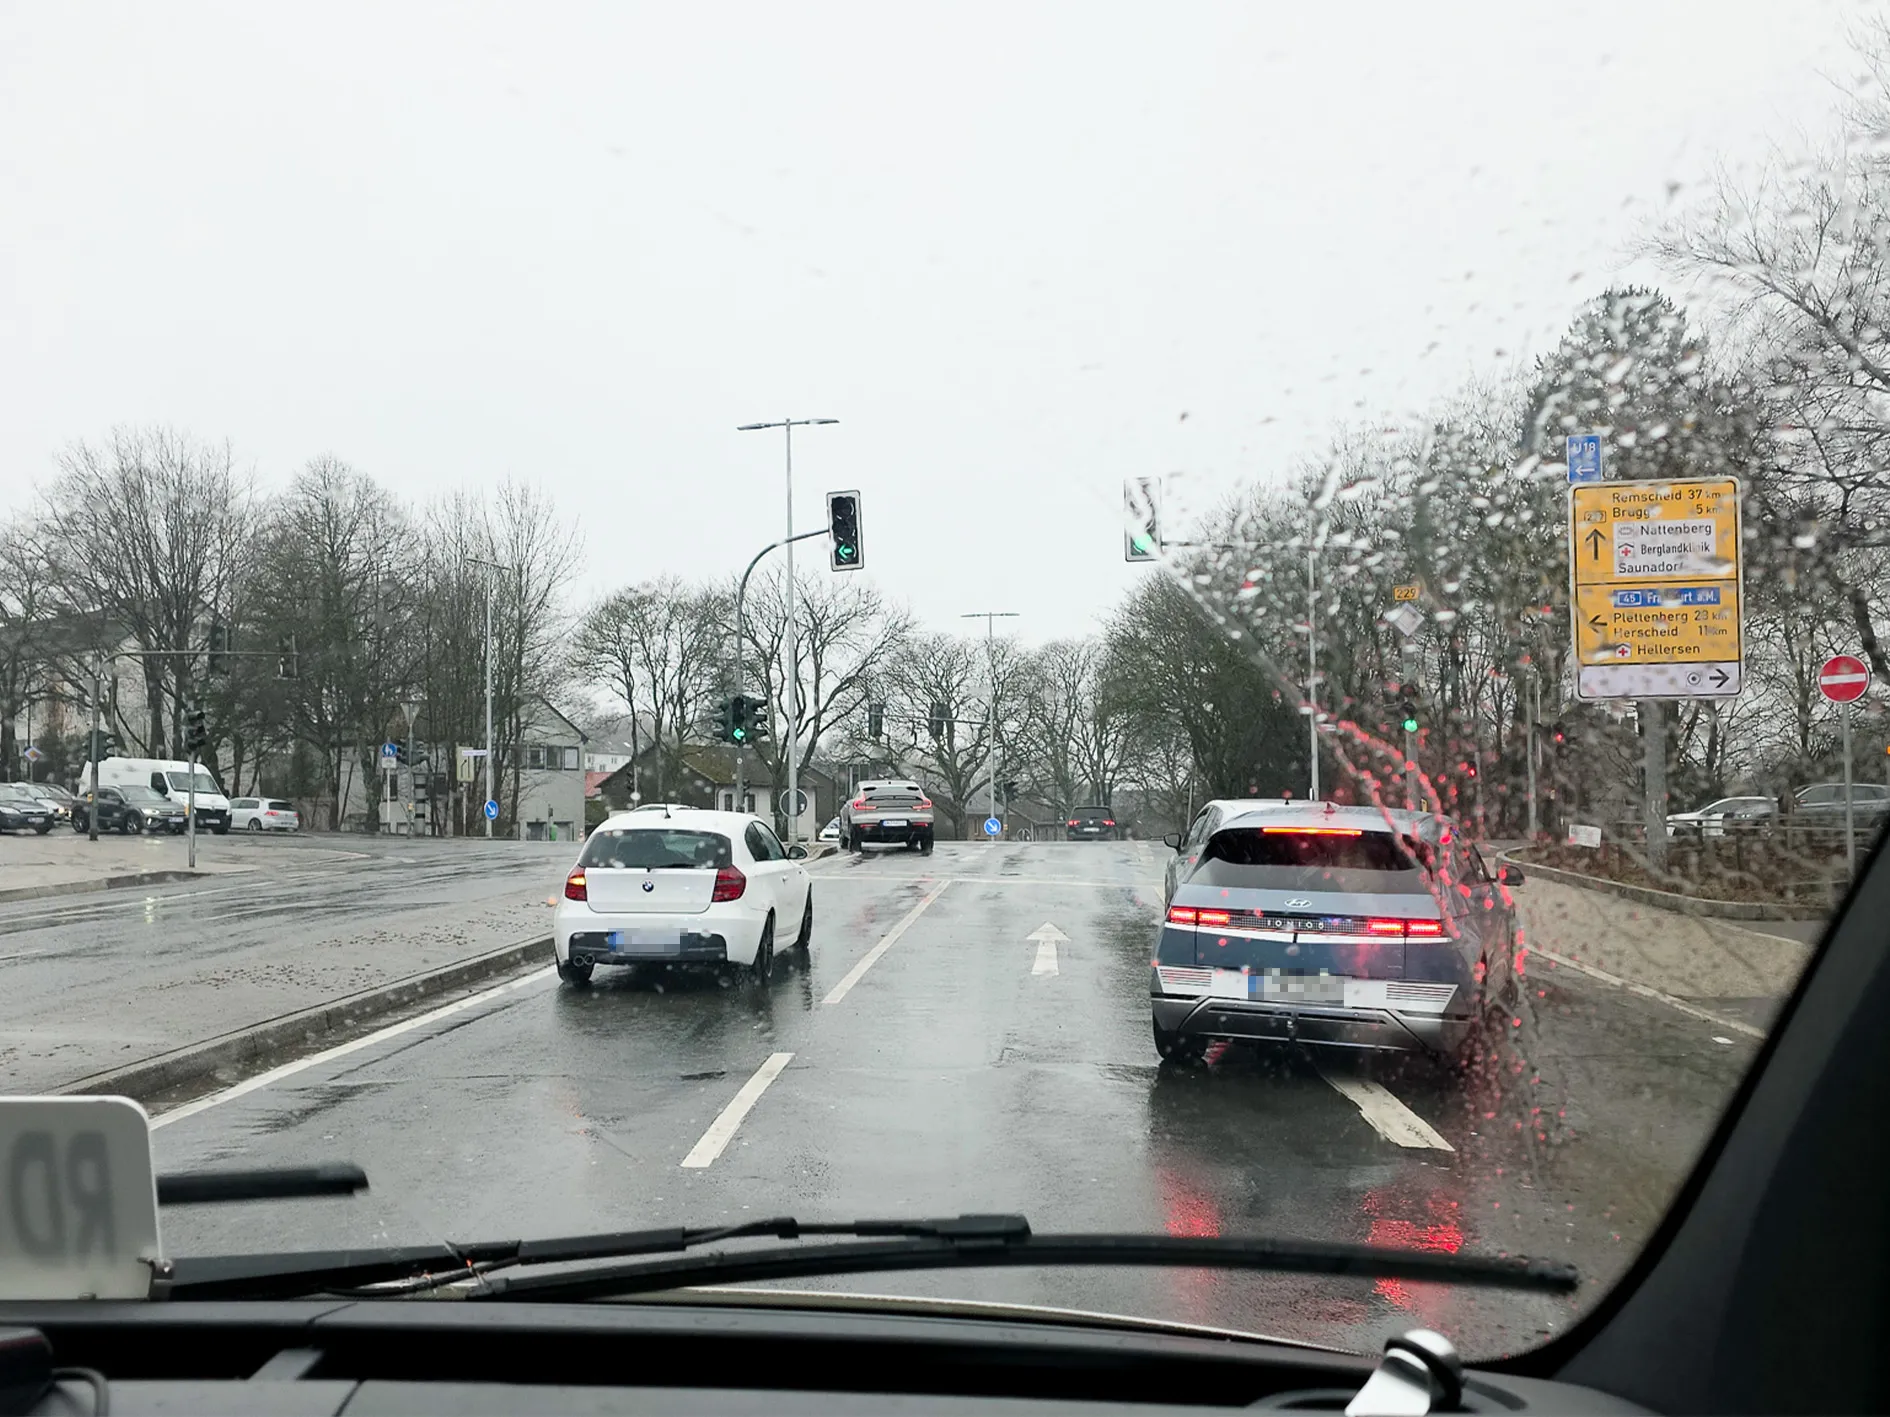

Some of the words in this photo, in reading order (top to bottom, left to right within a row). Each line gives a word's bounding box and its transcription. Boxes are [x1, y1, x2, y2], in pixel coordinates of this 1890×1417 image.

[1612, 489, 1682, 503] Remscheid
[1688, 488, 1702, 500] 37
[1706, 490, 1721, 499] km
[1696, 504, 1703, 514] 5
[1640, 523, 1712, 536] Nattenberg
[1641, 542, 1710, 557] Berglandklik
[1396, 587, 1417, 599] 229
[1623, 594, 1636, 602] 45
[1613, 611, 1688, 624] Plettenberg
[1613, 626, 1679, 638] Herscheid
[1698, 625, 1708, 636] 11
[1637, 643, 1701, 656] Hellersen
